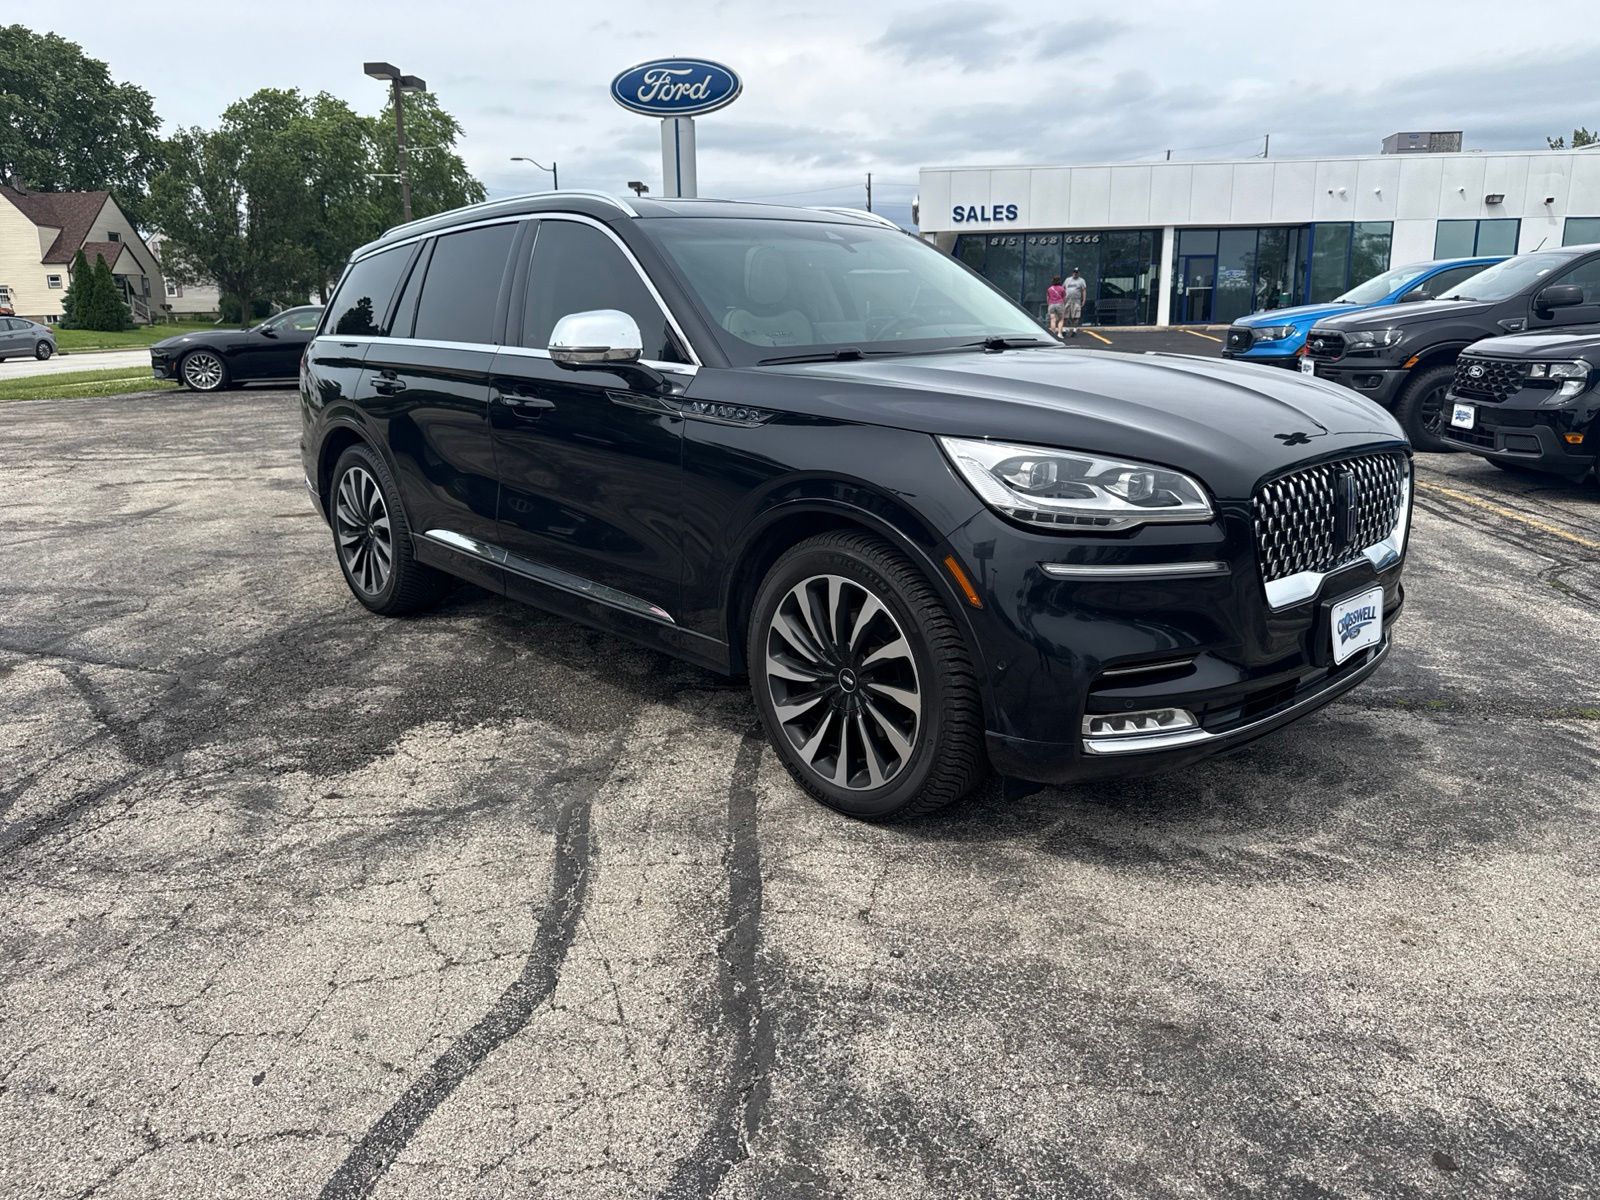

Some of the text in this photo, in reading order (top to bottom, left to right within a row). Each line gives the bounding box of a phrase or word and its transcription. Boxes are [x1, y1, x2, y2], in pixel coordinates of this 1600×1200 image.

[637, 68, 713, 102] Ford
[952, 204, 1018, 222] SALES
[990, 236, 1018, 246] 815
[690, 401, 760, 421] AVIATOR
